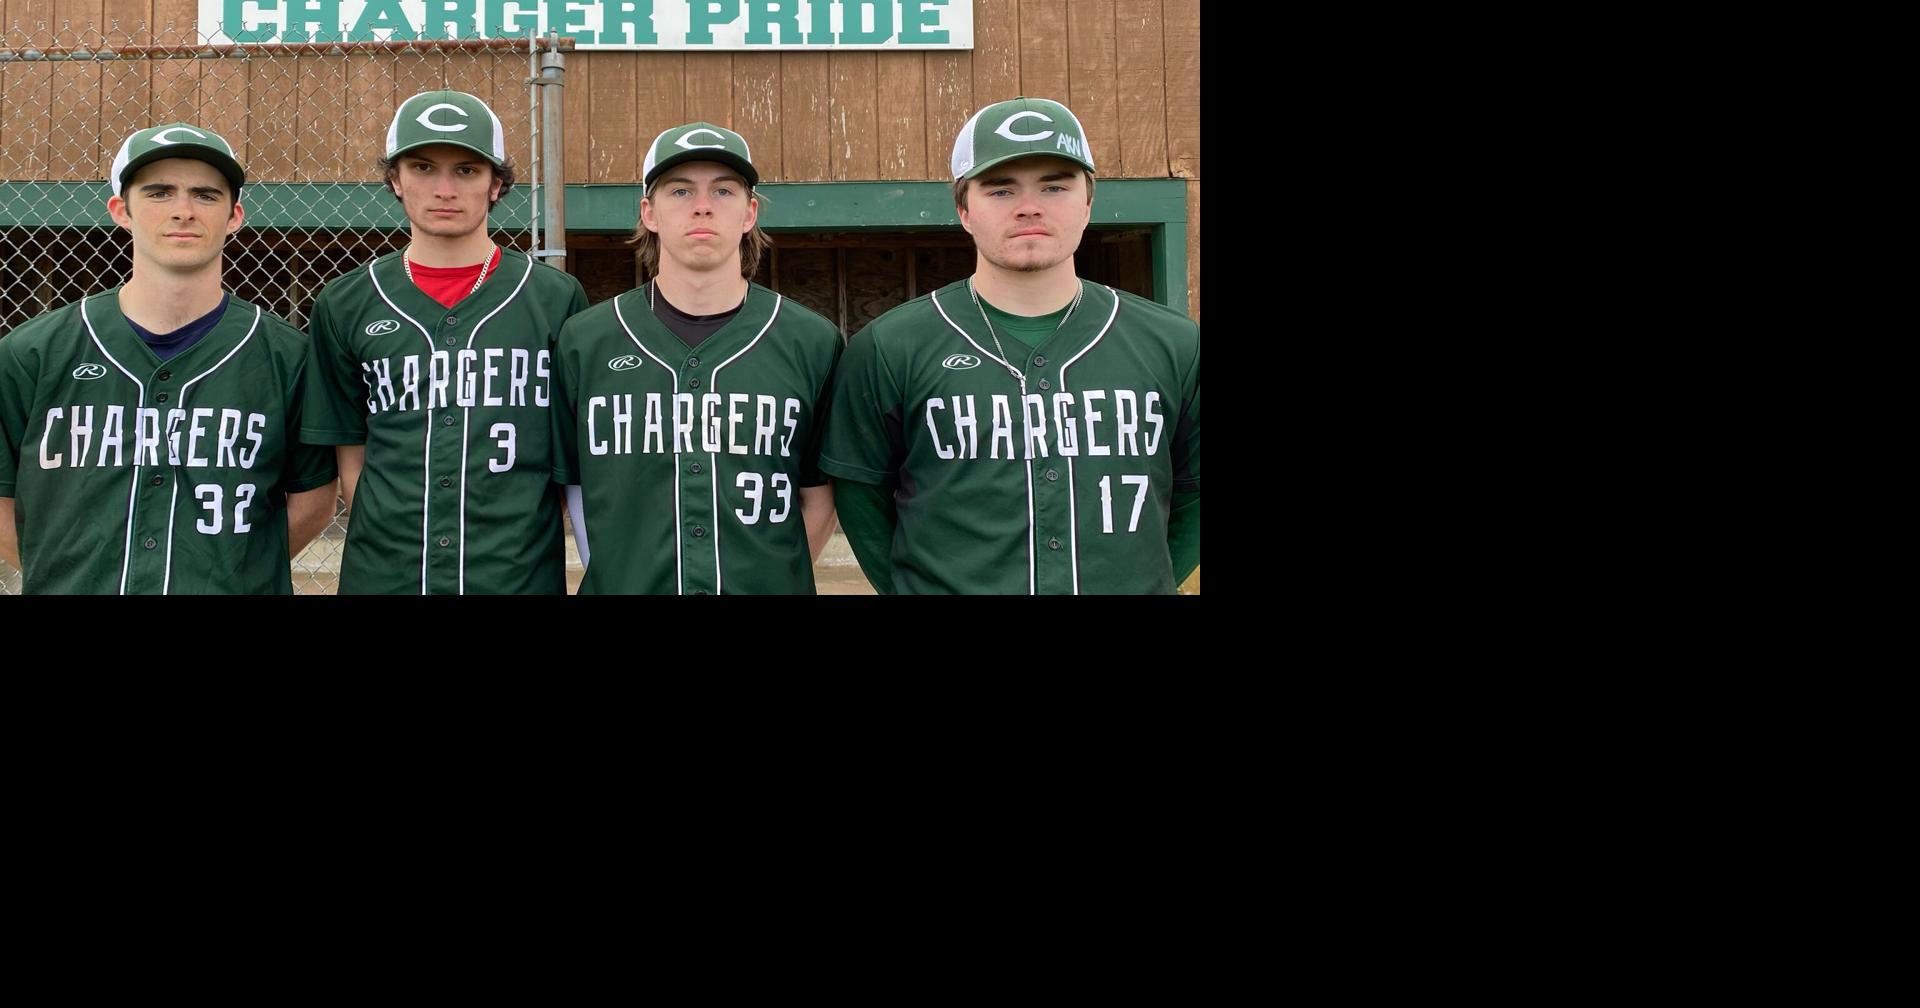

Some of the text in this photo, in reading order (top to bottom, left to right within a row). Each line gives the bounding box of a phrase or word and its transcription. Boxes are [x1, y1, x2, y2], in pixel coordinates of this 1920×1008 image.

[222, 0, 950, 44] CHARGER PRIDE
[415, 103, 469, 132] C
[994, 110, 1055, 142] C
[39, 405, 266, 470] CHARGERS
[488, 422, 517, 474] 3
[588, 393, 801, 457] CHARGERS
[926, 389, 1164, 460] CHARGERS
[194, 483, 257, 536] 32
[734, 471, 792, 526] 33
[1098, 474, 1150, 534] 17
